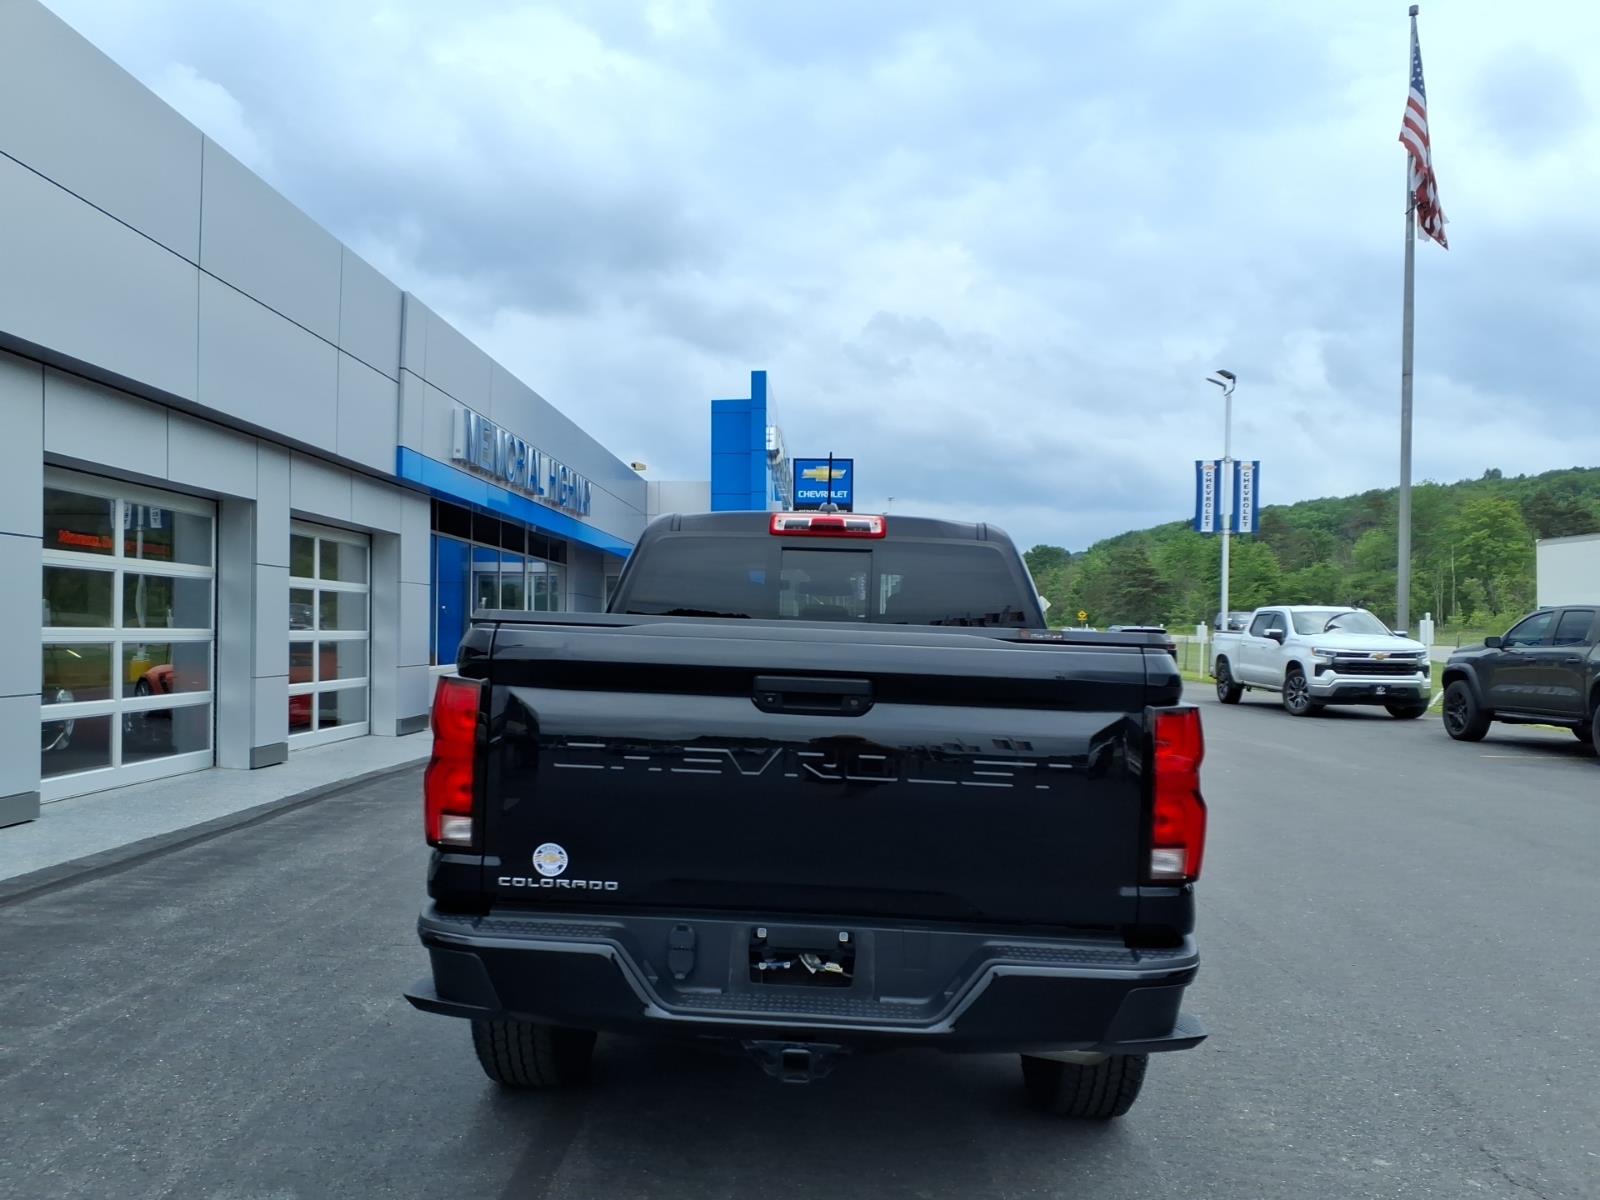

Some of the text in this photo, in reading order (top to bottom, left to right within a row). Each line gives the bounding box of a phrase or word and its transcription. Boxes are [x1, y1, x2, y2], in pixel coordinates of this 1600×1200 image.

[798, 490, 848, 498] CHEVRLET
[1242, 471, 1250, 527] CHEVROLET
[498, 876, 618, 891] COLORADO
